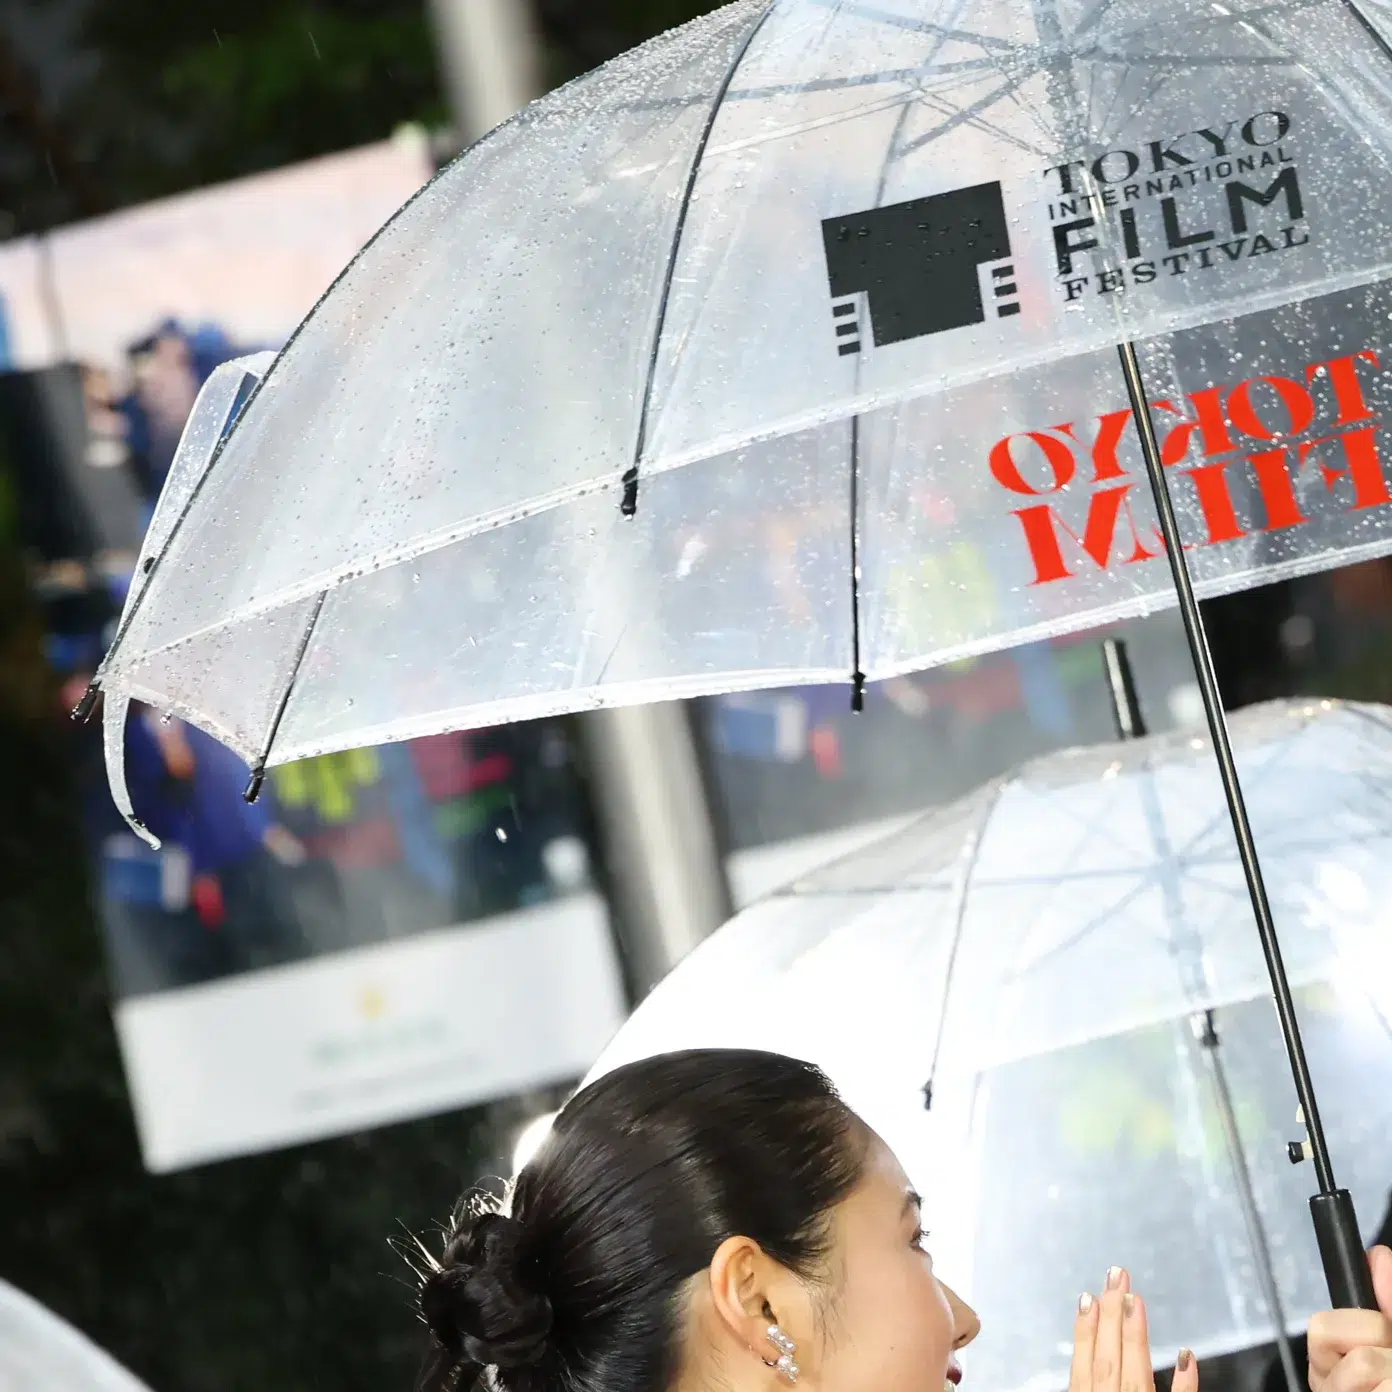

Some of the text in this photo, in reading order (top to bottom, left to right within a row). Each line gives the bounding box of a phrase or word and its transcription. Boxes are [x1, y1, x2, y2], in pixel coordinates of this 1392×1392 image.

[1043, 111, 1290, 196] TOKYO
[1048, 147, 1293, 220] INTERNATIONAL
[1053, 167, 1304, 275] FILM
[1062, 227, 1309, 301] FESTIVAL
